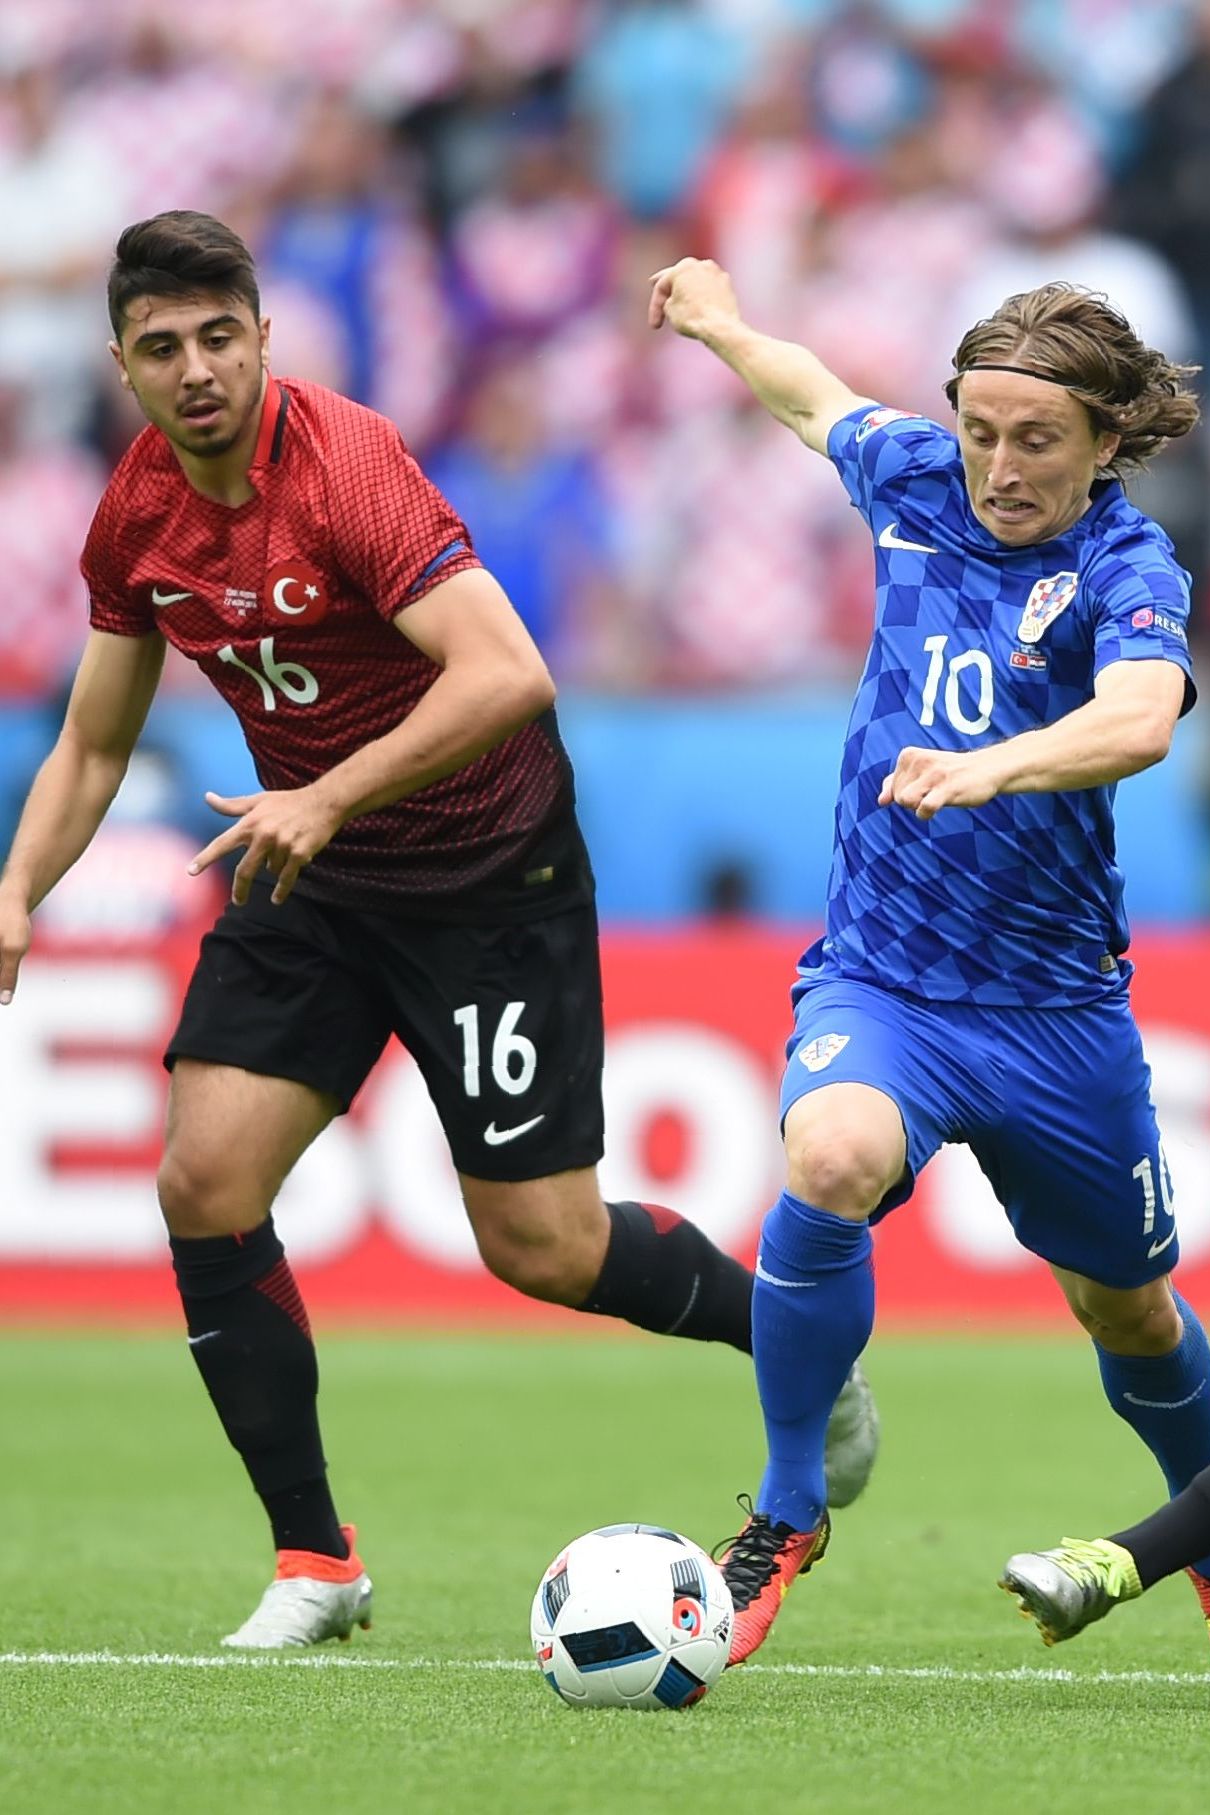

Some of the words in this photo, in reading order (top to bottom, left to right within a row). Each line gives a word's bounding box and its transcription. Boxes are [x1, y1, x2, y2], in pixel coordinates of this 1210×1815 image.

[216, 636, 319, 711] 16
[919, 635, 994, 736] 10
[454, 1001, 537, 1098] 16
